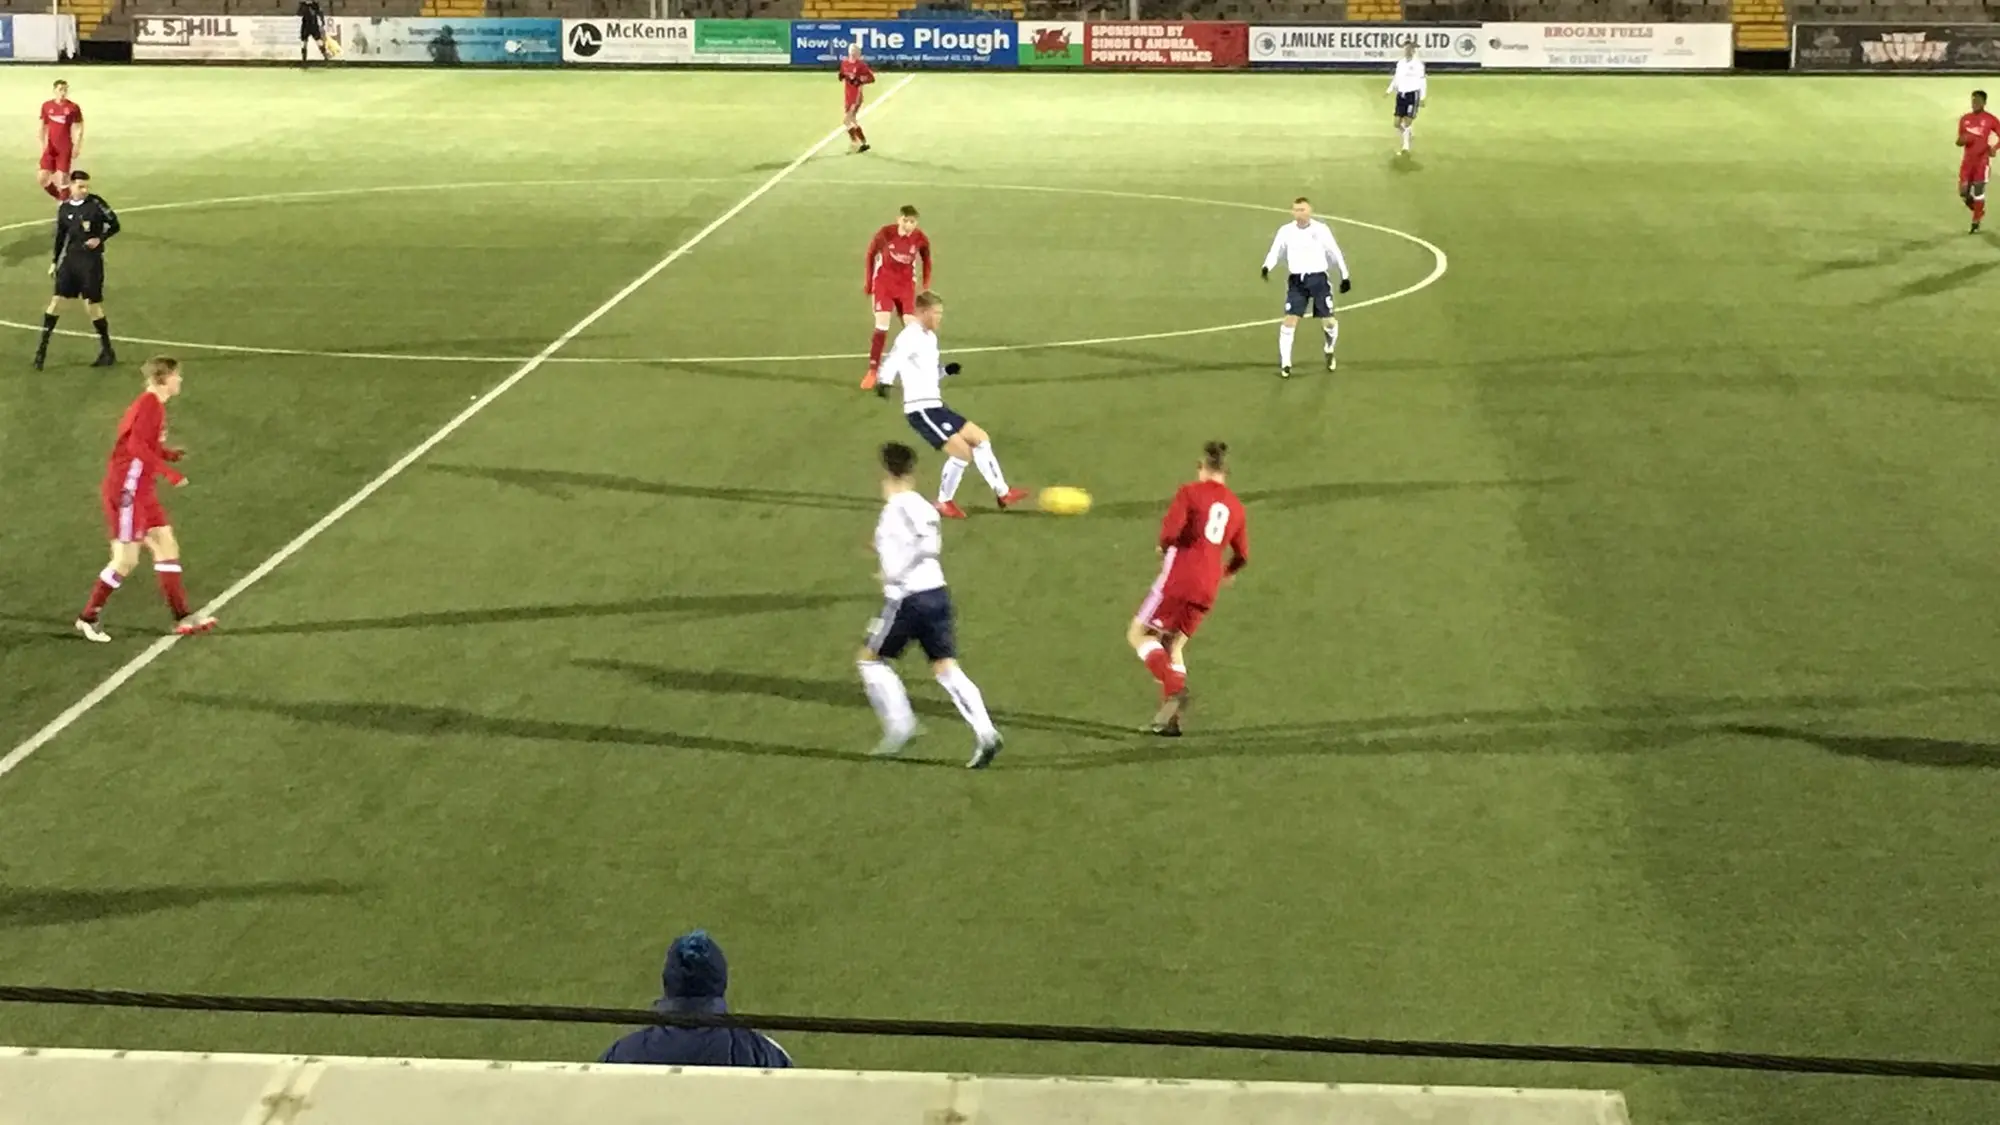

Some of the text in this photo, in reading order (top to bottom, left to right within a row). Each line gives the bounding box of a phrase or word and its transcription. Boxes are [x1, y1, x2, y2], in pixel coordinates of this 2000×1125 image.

[187, 18, 238, 36] HILL
[606, 23, 688, 39] McKenna
[1091, 25, 1185, 37] SPONSORED BY
[1543, 26, 1654, 38] BROGAN FUELS
[797, 37, 848, 49] Now to
[850, 28, 1010, 54] The Plough
[1091, 38, 1199, 50] SIMON & ANDREA,
[1340, 32, 1421, 48] ELECTRICAL
[1425, 33, 1451, 48] LTD
[1091, 50, 1213, 63] PONTYPOOL, WALES
[1204, 501, 1231, 545] 8
